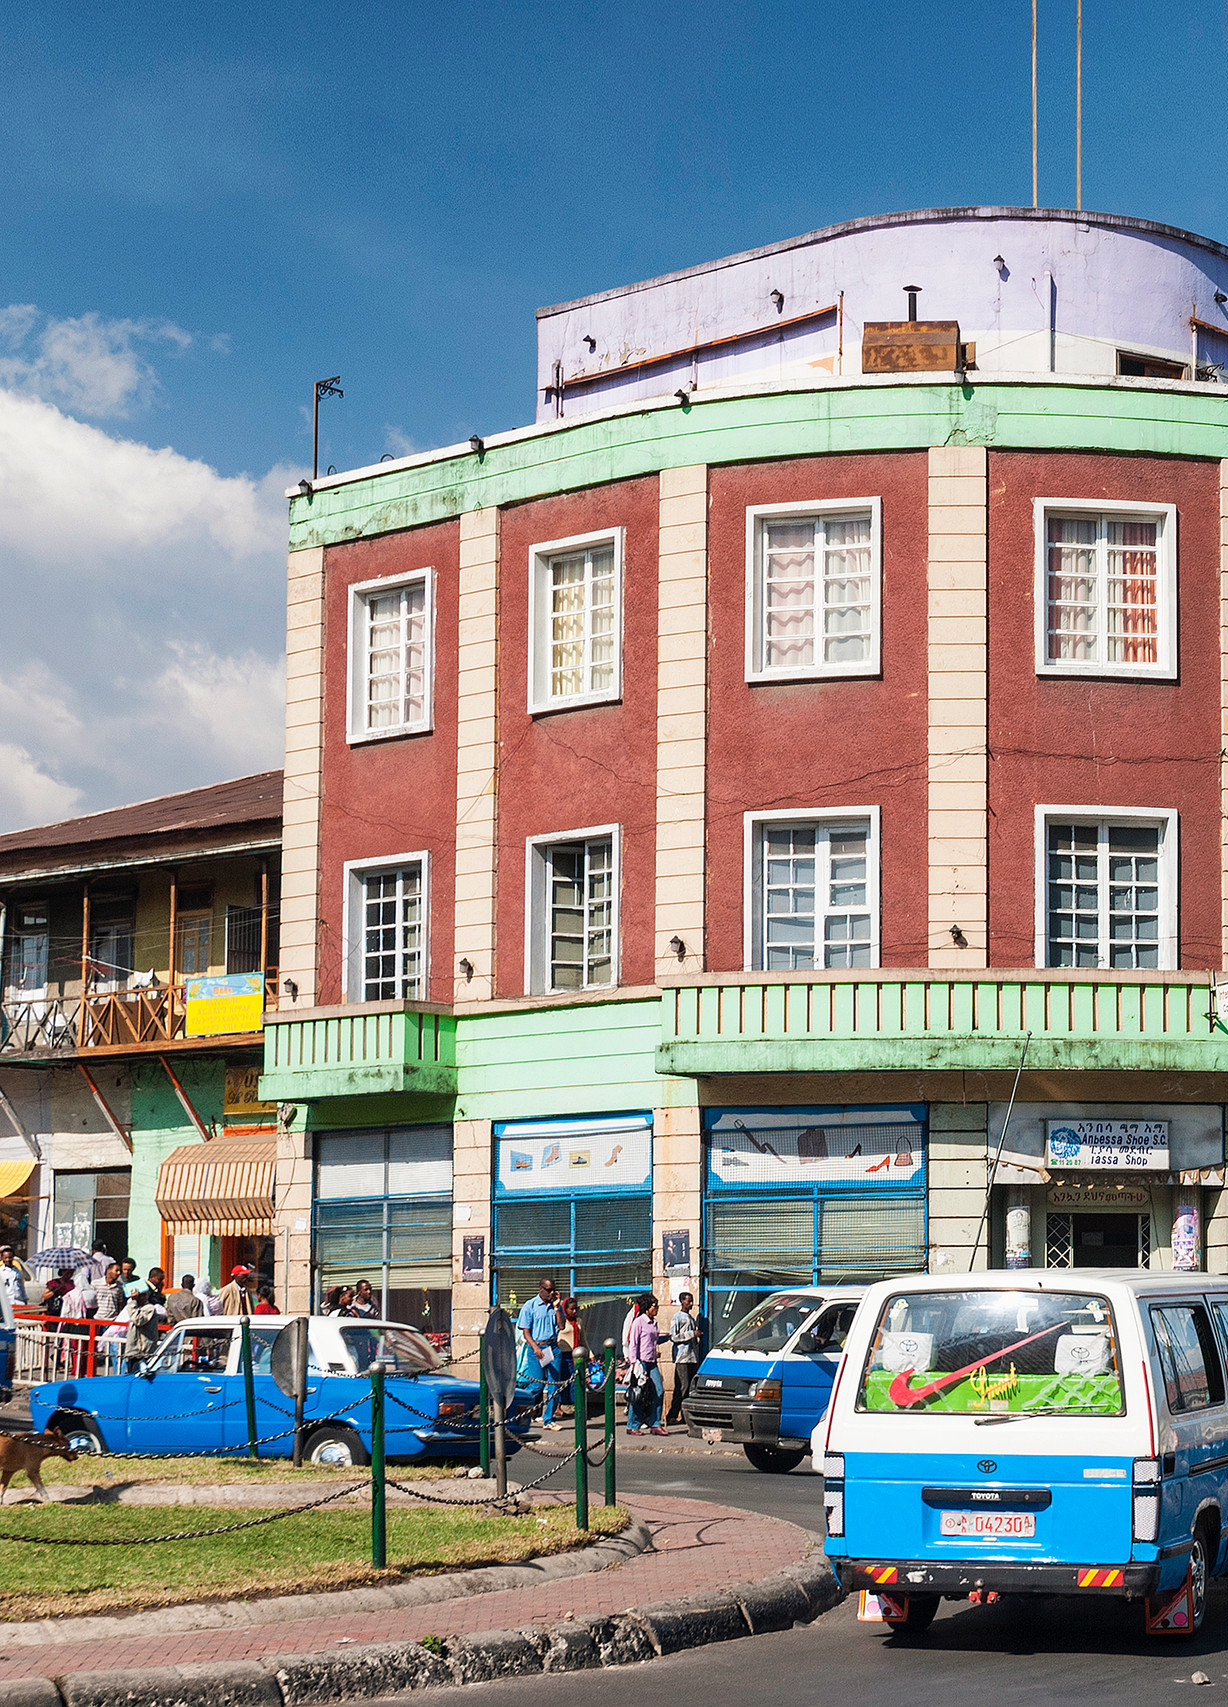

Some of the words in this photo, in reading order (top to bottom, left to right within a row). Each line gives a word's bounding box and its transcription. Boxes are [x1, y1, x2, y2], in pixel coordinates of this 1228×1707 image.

[1081, 1133, 1123, 1146] Anbessa
[1126, 1134, 1150, 1146] Shoe
[1153, 1134, 1168, 1146] S.C.
[1125, 1154, 1148, 1167] Shop
[971, 1492, 1000, 1500] TOYOTA
[975, 1516, 1022, 1533] 04230
